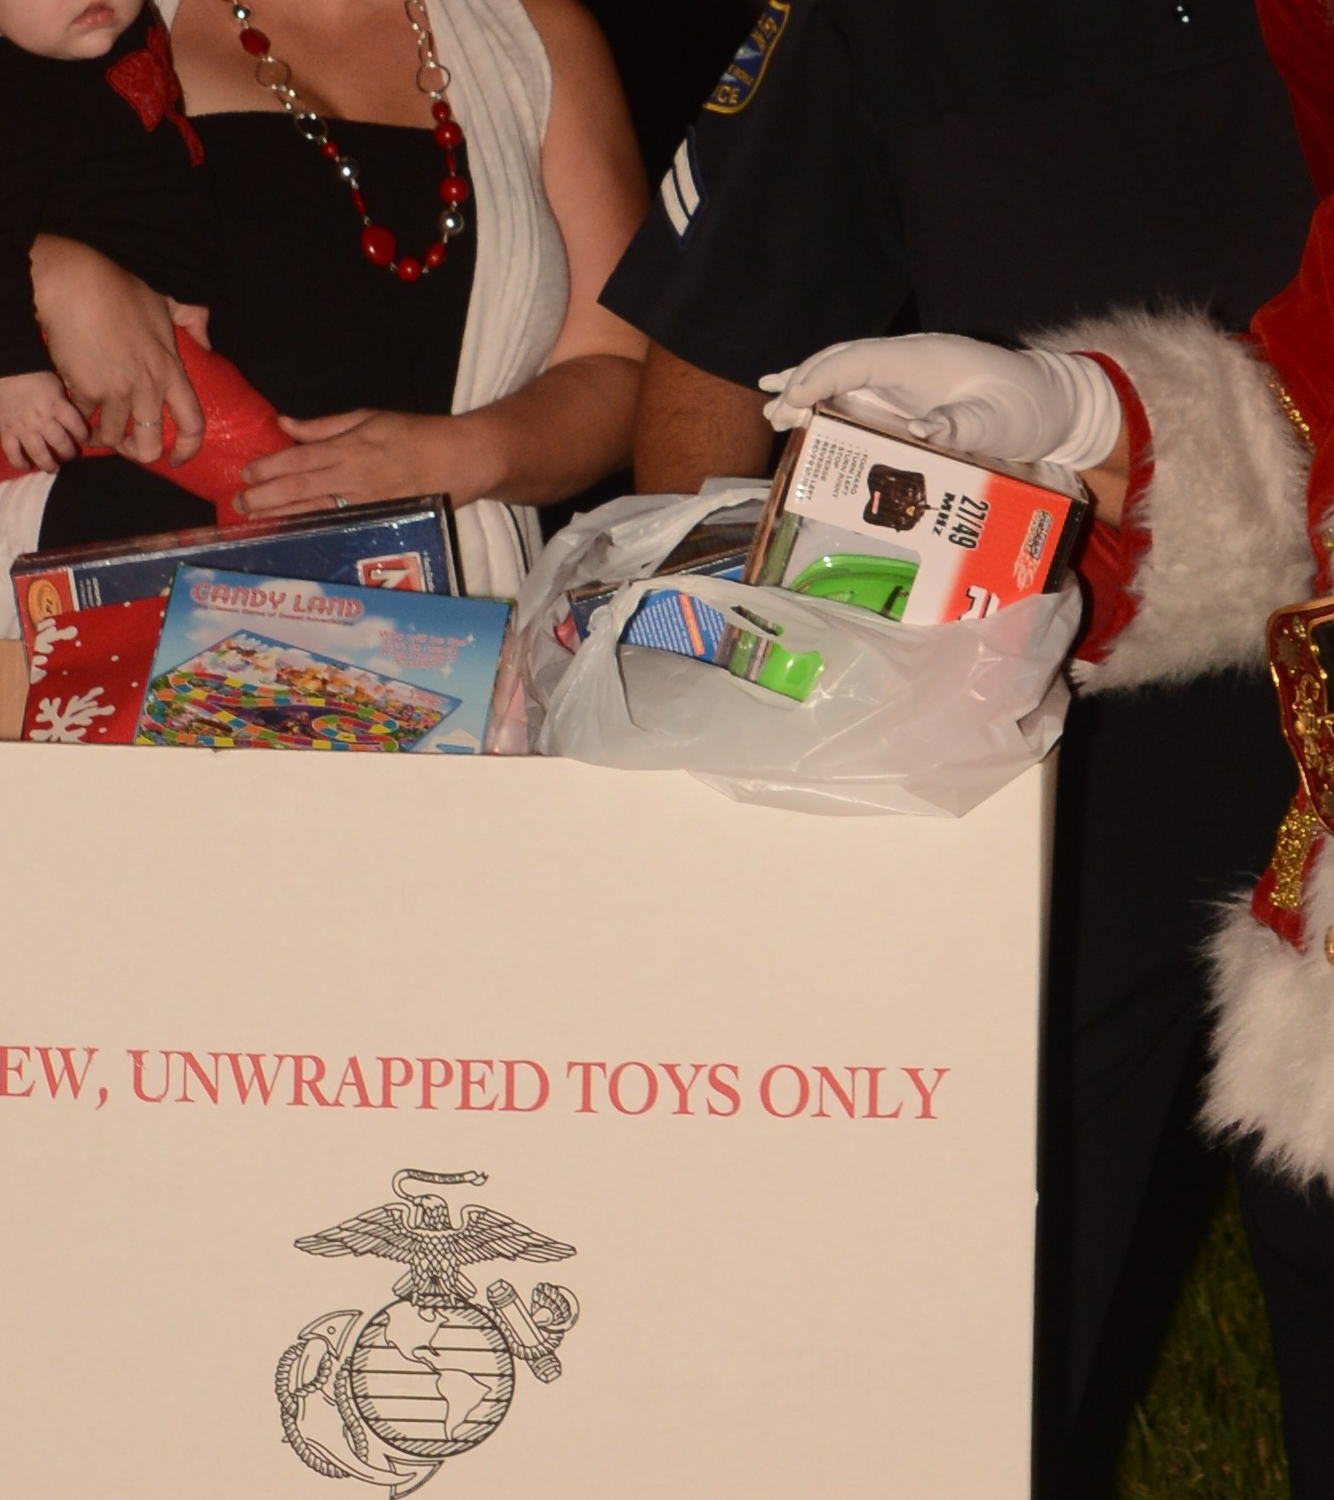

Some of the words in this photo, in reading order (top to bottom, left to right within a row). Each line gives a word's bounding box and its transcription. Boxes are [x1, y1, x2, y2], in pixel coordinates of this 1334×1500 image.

[932, 491, 956, 537] MHz
[948, 495, 989, 549] 27/49
[192, 581, 287, 610] CANDY
[292, 592, 364, 618] LAND
[127, 1050, 550, 1112] UNWRAPPED
[567, 1061, 742, 1117] TOYS
[759, 1065, 950, 1119] ONLY
